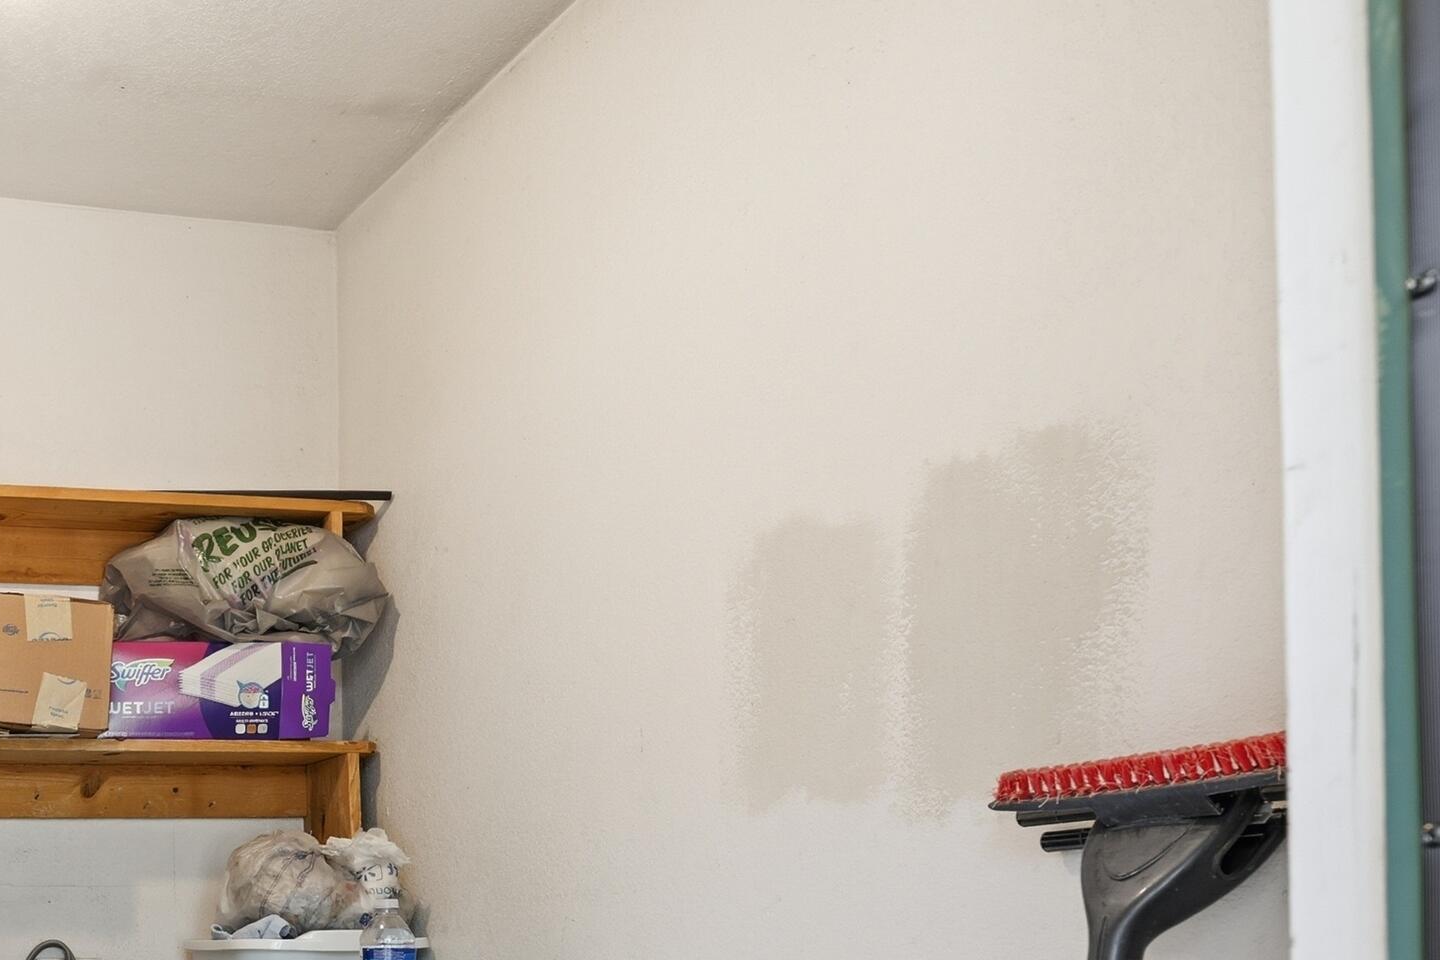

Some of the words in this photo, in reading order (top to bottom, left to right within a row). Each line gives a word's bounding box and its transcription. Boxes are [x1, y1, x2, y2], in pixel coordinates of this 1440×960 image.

[212, 567, 232, 590] FOR
[231, 572, 252, 595] FOR
[252, 557, 275, 578] OUR
[239, 583, 260, 607] FOR
[111, 660, 171, 688] Swiffer
